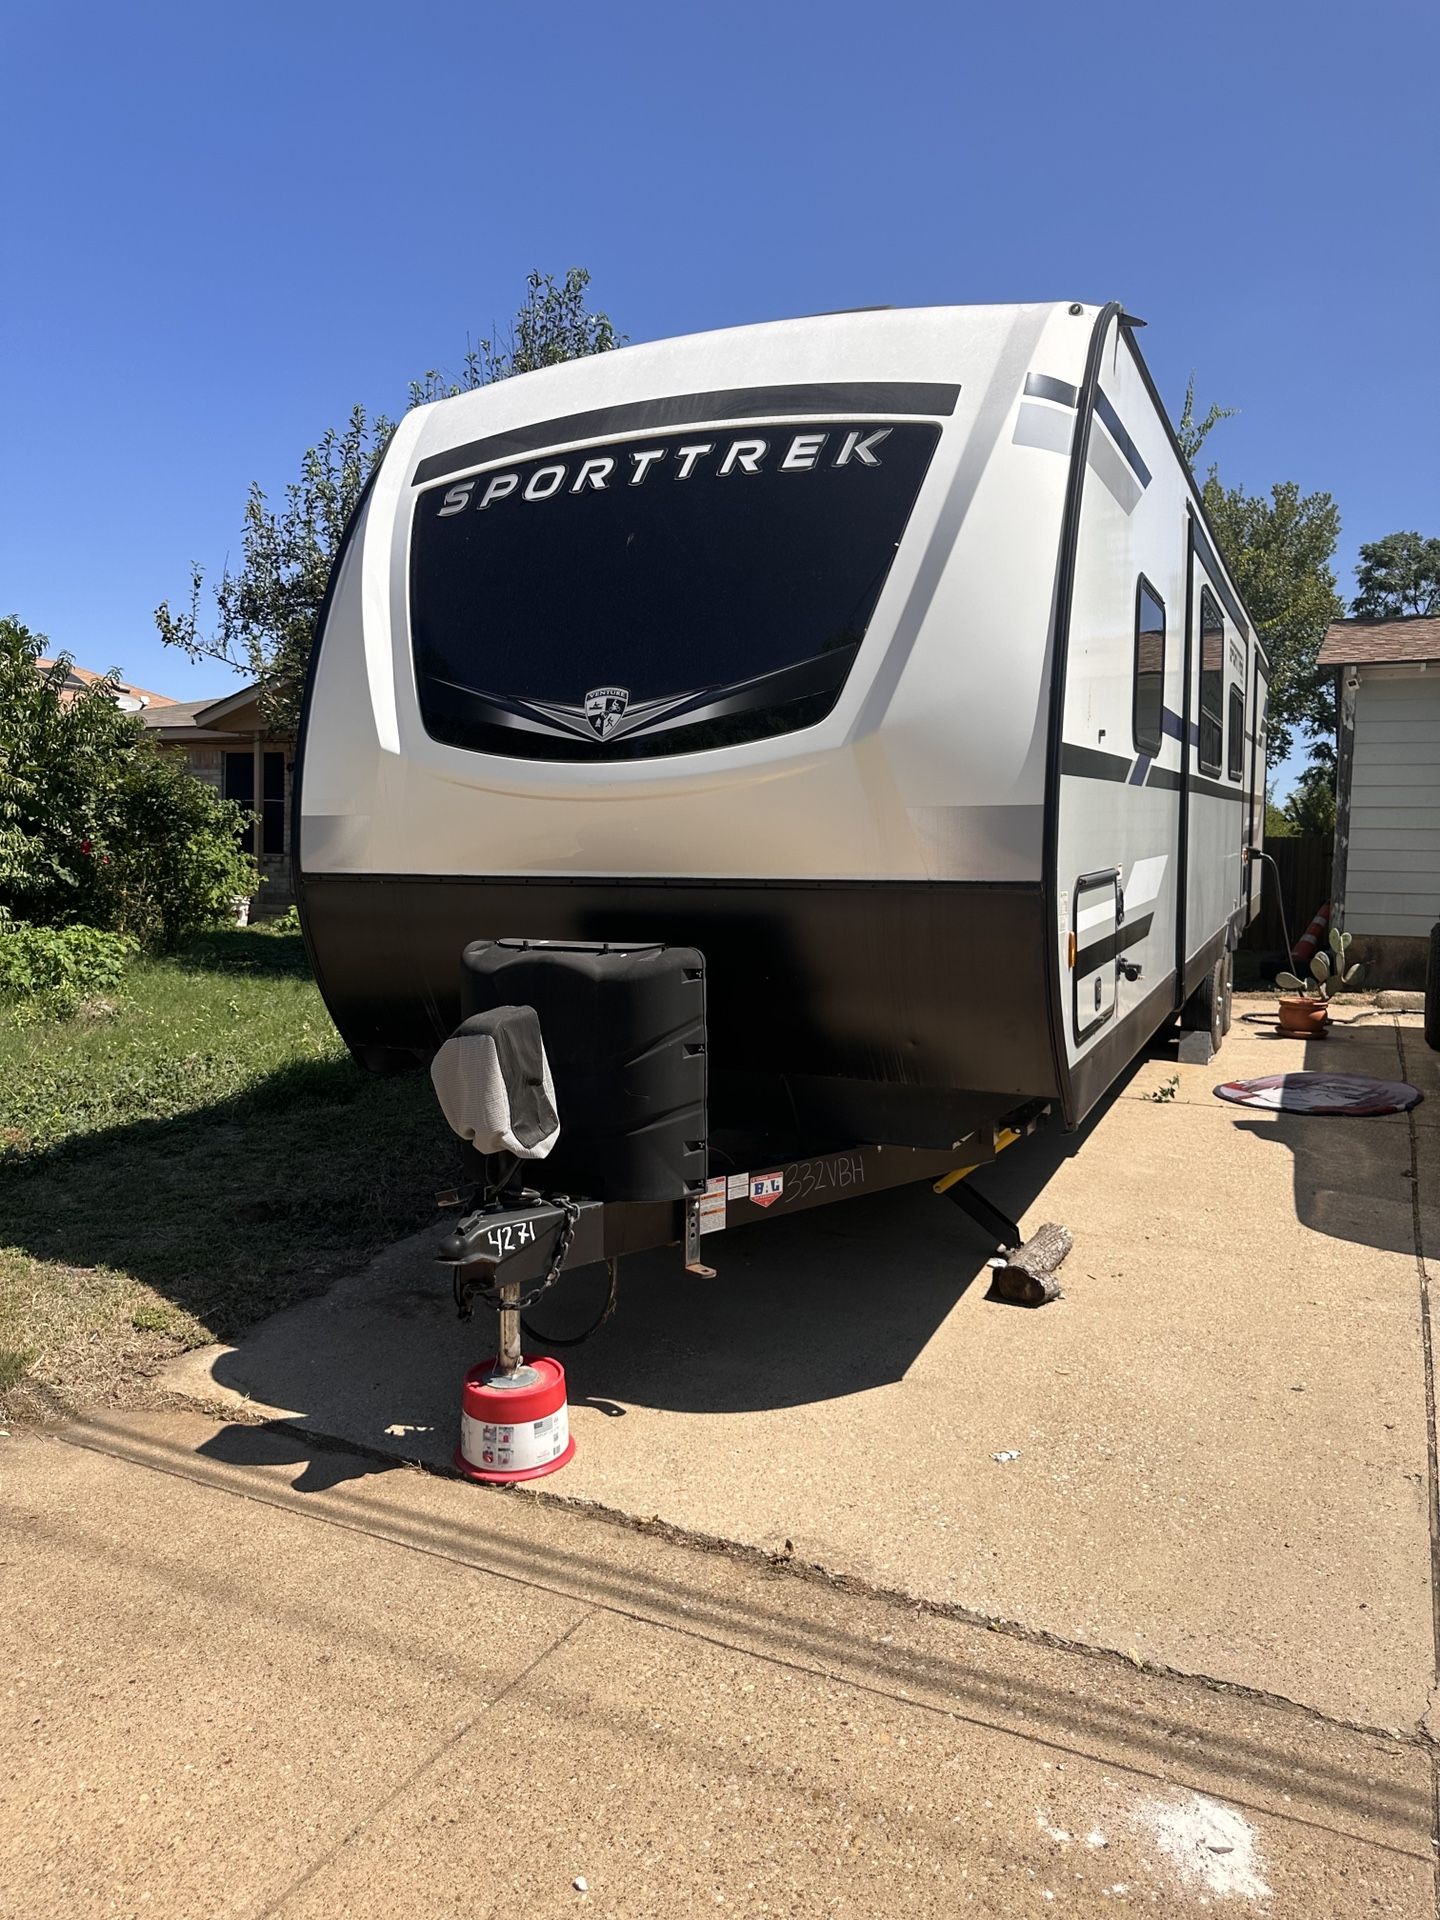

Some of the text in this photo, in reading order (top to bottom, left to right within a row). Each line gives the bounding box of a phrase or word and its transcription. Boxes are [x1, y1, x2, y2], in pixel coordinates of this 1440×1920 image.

[437, 427, 894, 518] SPORTTREK
[589, 689, 626, 698] VENTURE
[784, 1155, 865, 1203] 332VBH
[487, 1221, 536, 1257] 4271
